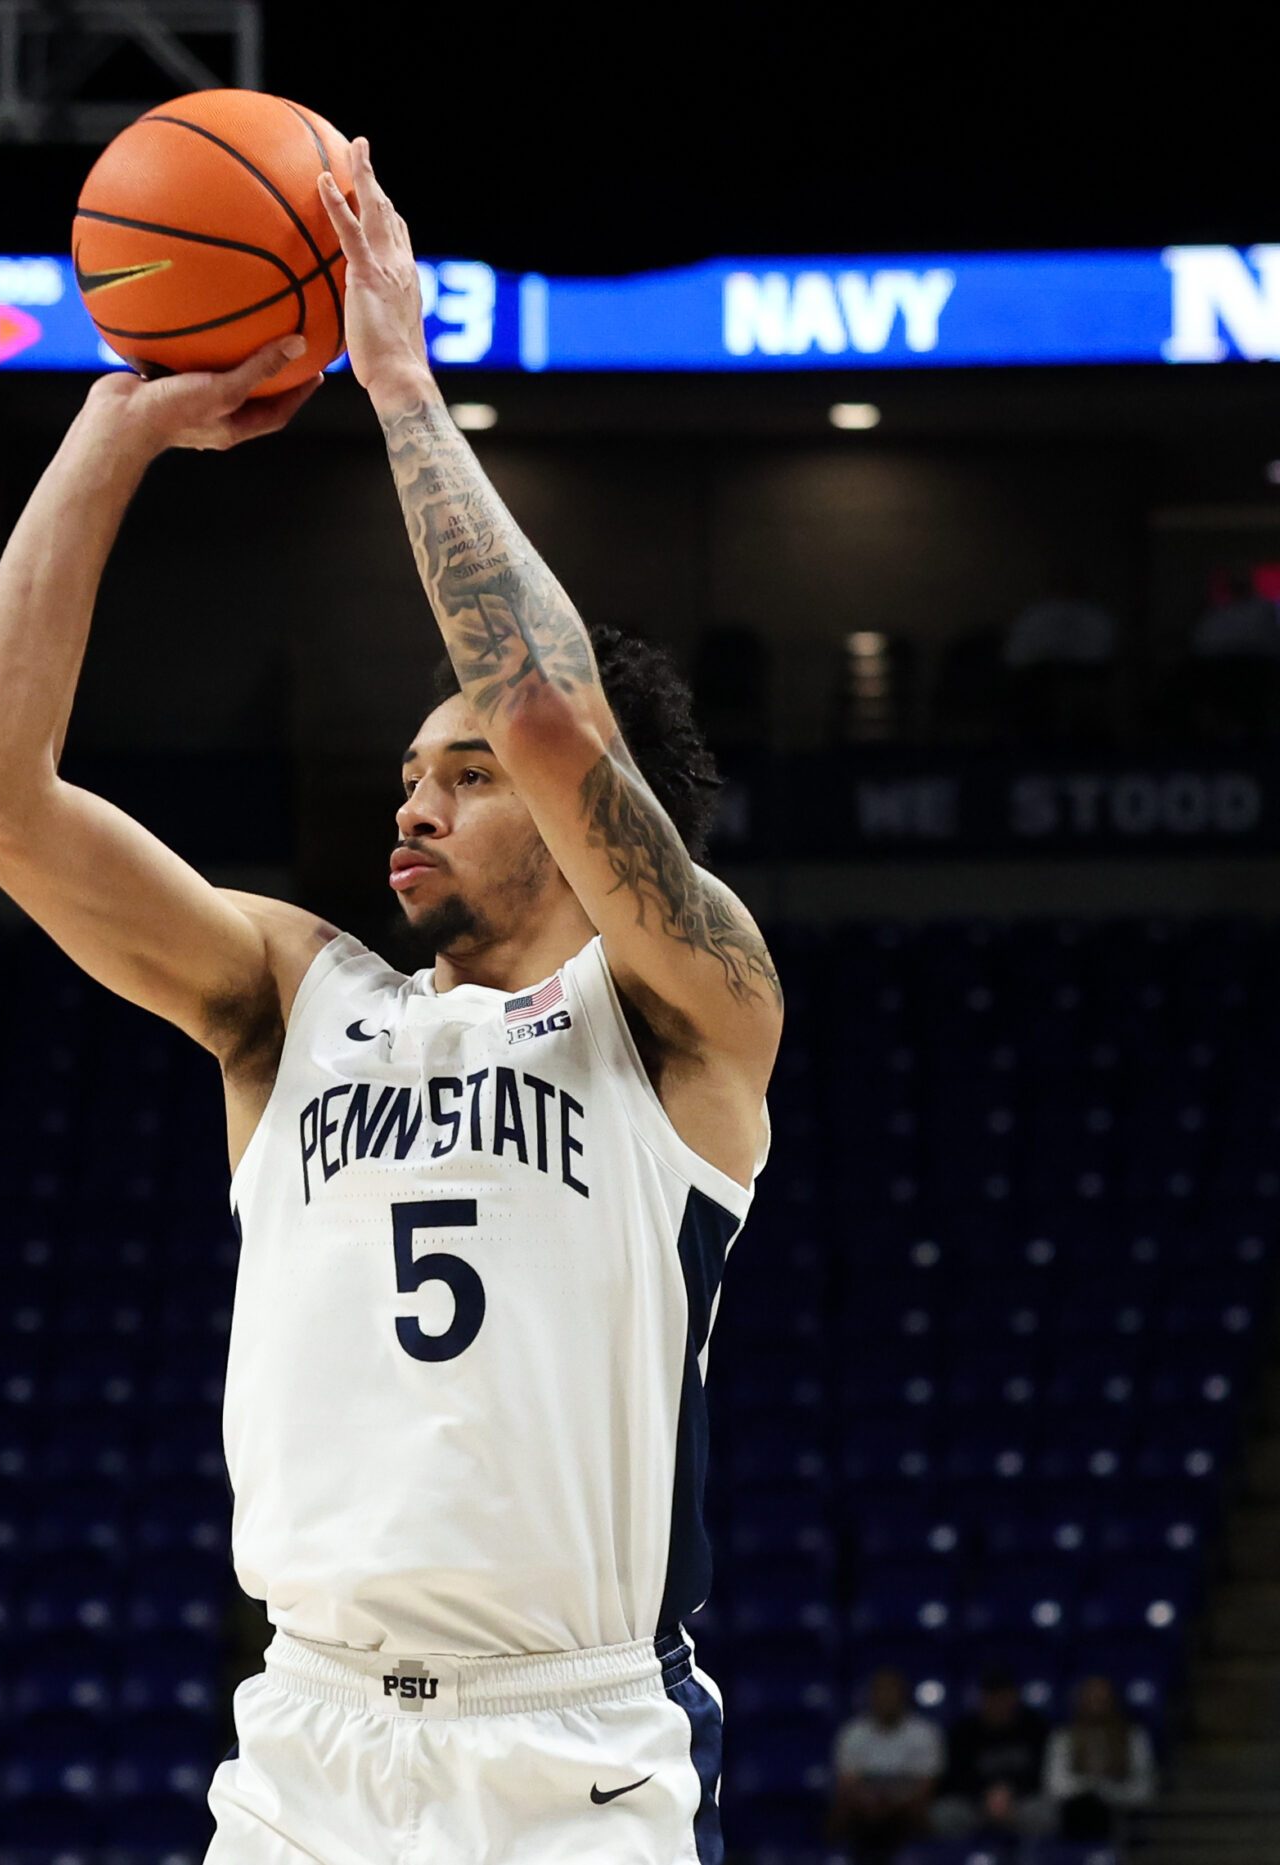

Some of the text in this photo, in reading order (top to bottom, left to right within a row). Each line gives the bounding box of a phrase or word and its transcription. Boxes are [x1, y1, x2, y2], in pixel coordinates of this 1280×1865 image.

[417, 262, 496, 362] 3
[724, 270, 954, 356] NAVY
[858, 773, 1263, 836] WE STOOD
[300, 1066, 590, 1206] PENN STATE
[390, 1198, 486, 1363] 5
[382, 1675, 439, 1700] PSU
